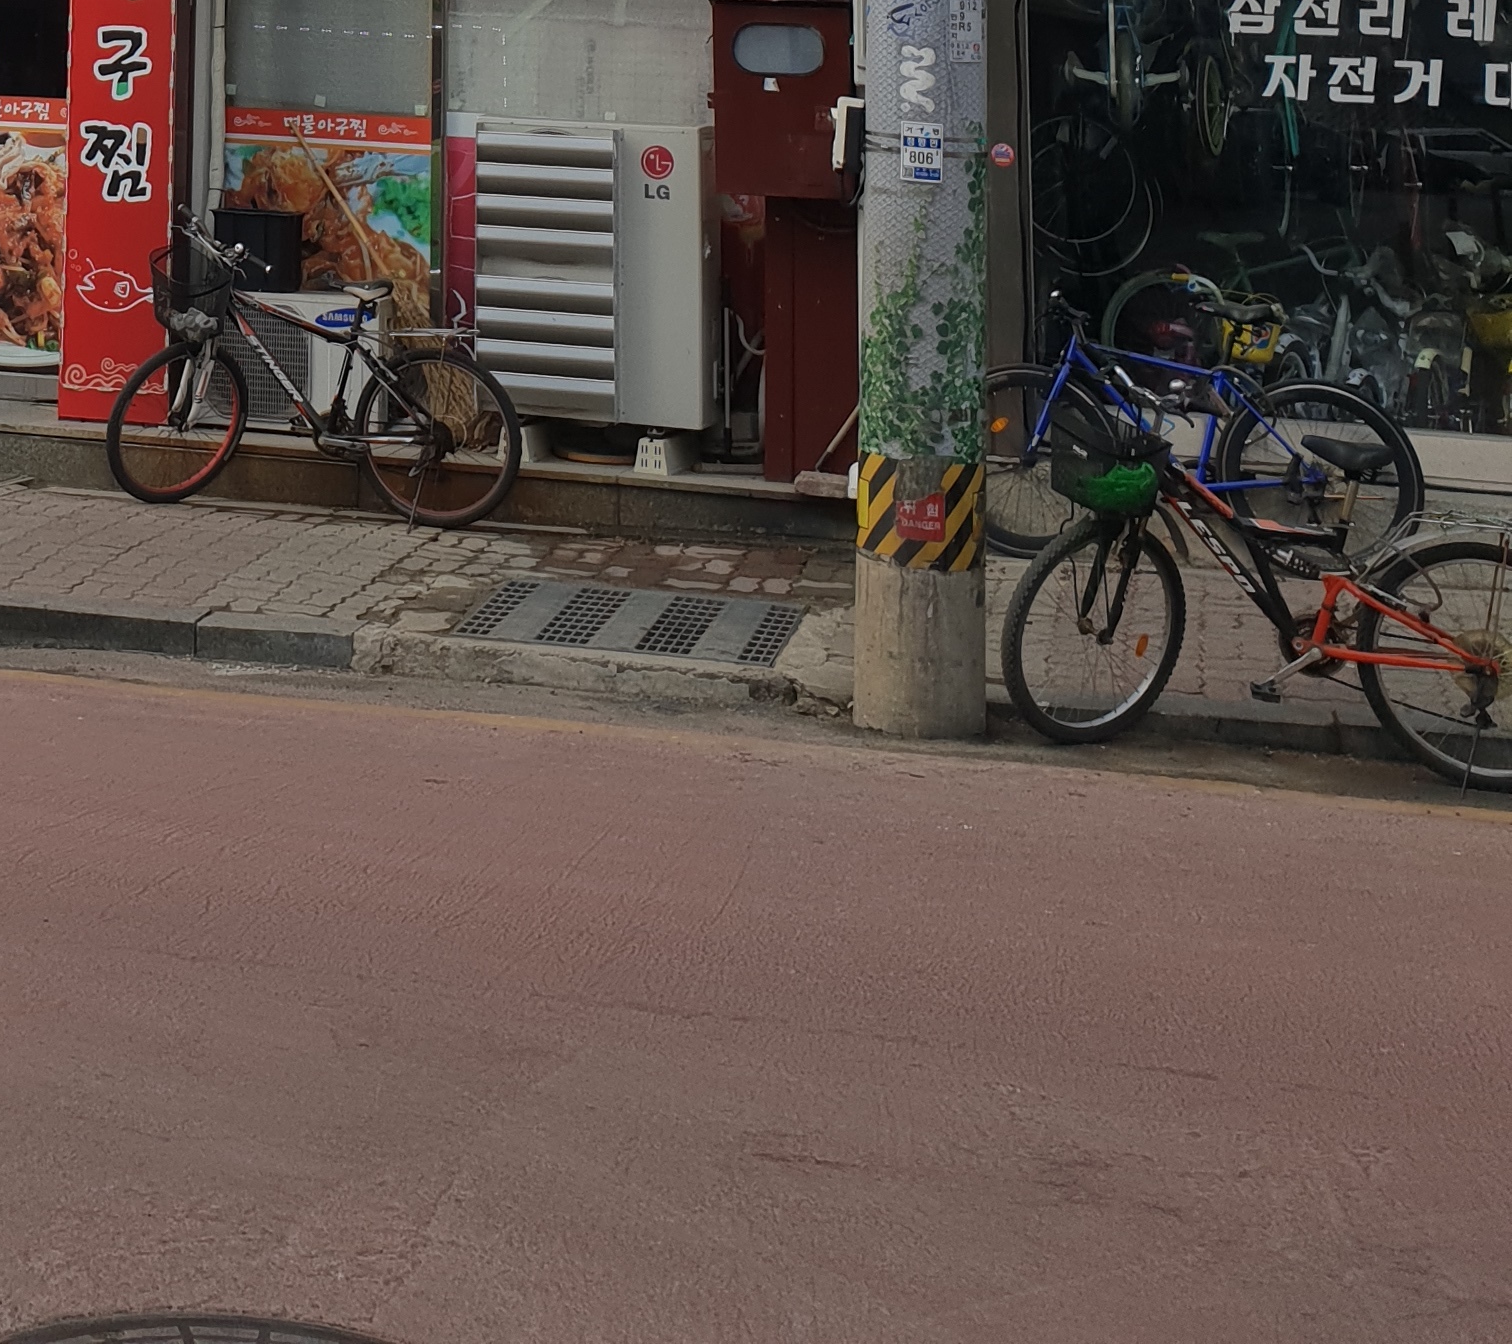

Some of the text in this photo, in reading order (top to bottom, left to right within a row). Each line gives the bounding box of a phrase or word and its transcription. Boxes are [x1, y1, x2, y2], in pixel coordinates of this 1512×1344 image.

[1262, 54, 1444, 107] 자전거
[909, 150, 933, 165] 806
[644, 184, 670, 200] LG
[901, 517, 941, 530] DANGER
[1176, 501, 1256, 593] LESPO
